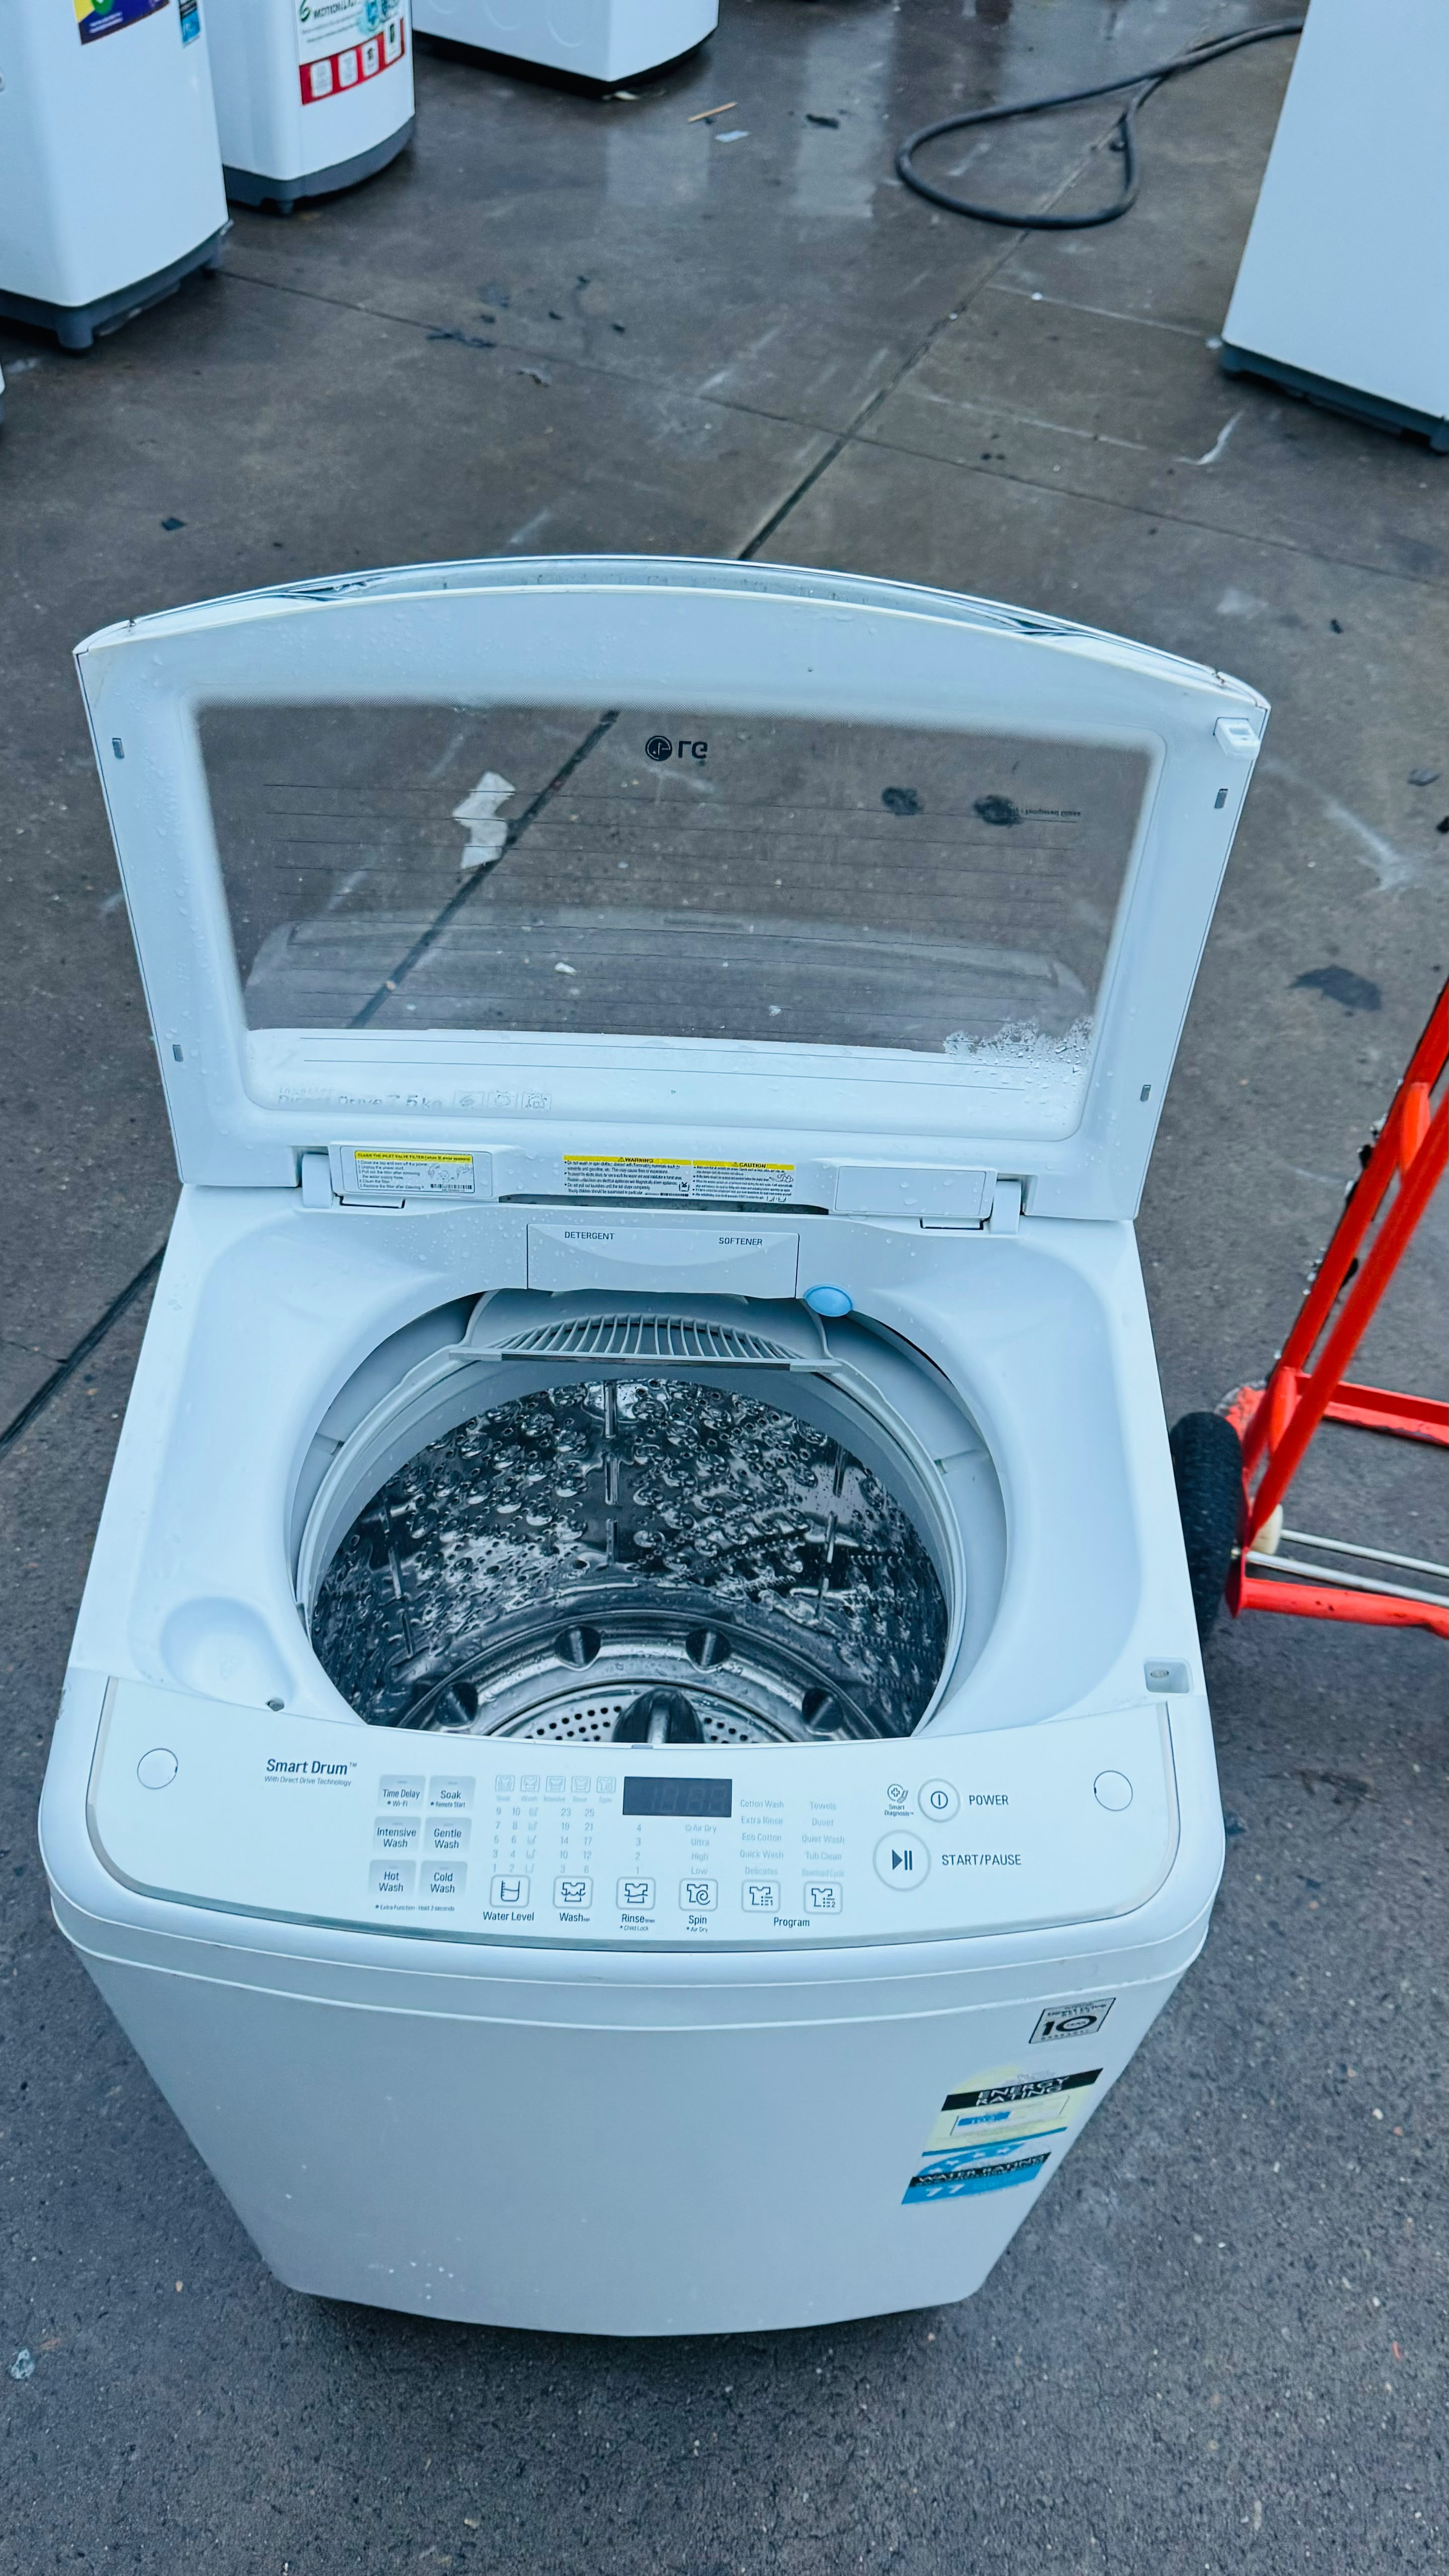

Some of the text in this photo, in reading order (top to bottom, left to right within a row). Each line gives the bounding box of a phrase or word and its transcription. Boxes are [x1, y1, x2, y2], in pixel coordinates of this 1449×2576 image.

[565, 1231, 615, 1240] DETERGENT
[719, 1237, 763, 1246] SOFTENER
[266, 1758, 307, 1774] Smart
[317, 1779, 352, 1787] Technology
[383, 1789, 420, 1800] Time Delay
[440, 1790, 461, 1800] Soak
[740, 1799, 784, 1808] Cotton Wash
[969, 1795, 1009, 1805] POWER
[810, 1801, 837, 1810] Towels
[496, 1807, 520, 1816] 9 10
[561, 1808, 594, 1817] 23 25
[495, 1821, 500, 1829] 7
[741, 1816, 783, 1825] Extra Rinse
[812, 1818, 834, 1827] Duvet
[585, 1823, 593, 1831] 21
[636, 1823, 641, 1832] 4
[704, 1825, 717, 1833] Dry
[377, 1828, 417, 1837] Intensive
[434, 1828, 462, 1838] Gentle
[757, 1833, 782, 1841] Cotton
[383, 1839, 408, 1848] Wash
[511, 1836, 516, 1844] 6
[560, 1836, 592, 1845] 14 17
[636, 1837, 641, 1846] 3
[691, 1839, 709, 1847] Ultra
[823, 1835, 845, 1844] Wash
[435, 1840, 459, 1849] Wash
[493, 1849, 515, 1859] 3 4
[559, 1850, 592, 1860] 10 12
[635, 1852, 640, 1860] 2
[691, 1853, 708, 1861] High
[740, 1849, 784, 1859] Quick Wash
[806, 1852, 842, 1861] Tub Clean
[942, 1854, 1022, 1866] START/PAUSE
[509, 1864, 515, 1873] 2
[691, 1867, 708, 1875] Low
[745, 1866, 778, 1875] Delicates
[384, 1872, 400, 1881] Hot
[434, 1873, 453, 1882] Cold
[379, 1883, 404, 1893] Wash
[430, 1884, 455, 1893] Wash
[483, 1911, 534, 1921] Water Level
[559, 1912, 584, 1922] Wash
[621, 1914, 645, 1923] Rinse
[688, 1915, 707, 1926] Spin
[774, 1917, 810, 1928] Program
[978, 2076, 1070, 2099] ENERGY
[976, 2085, 1063, 2106] RATING
